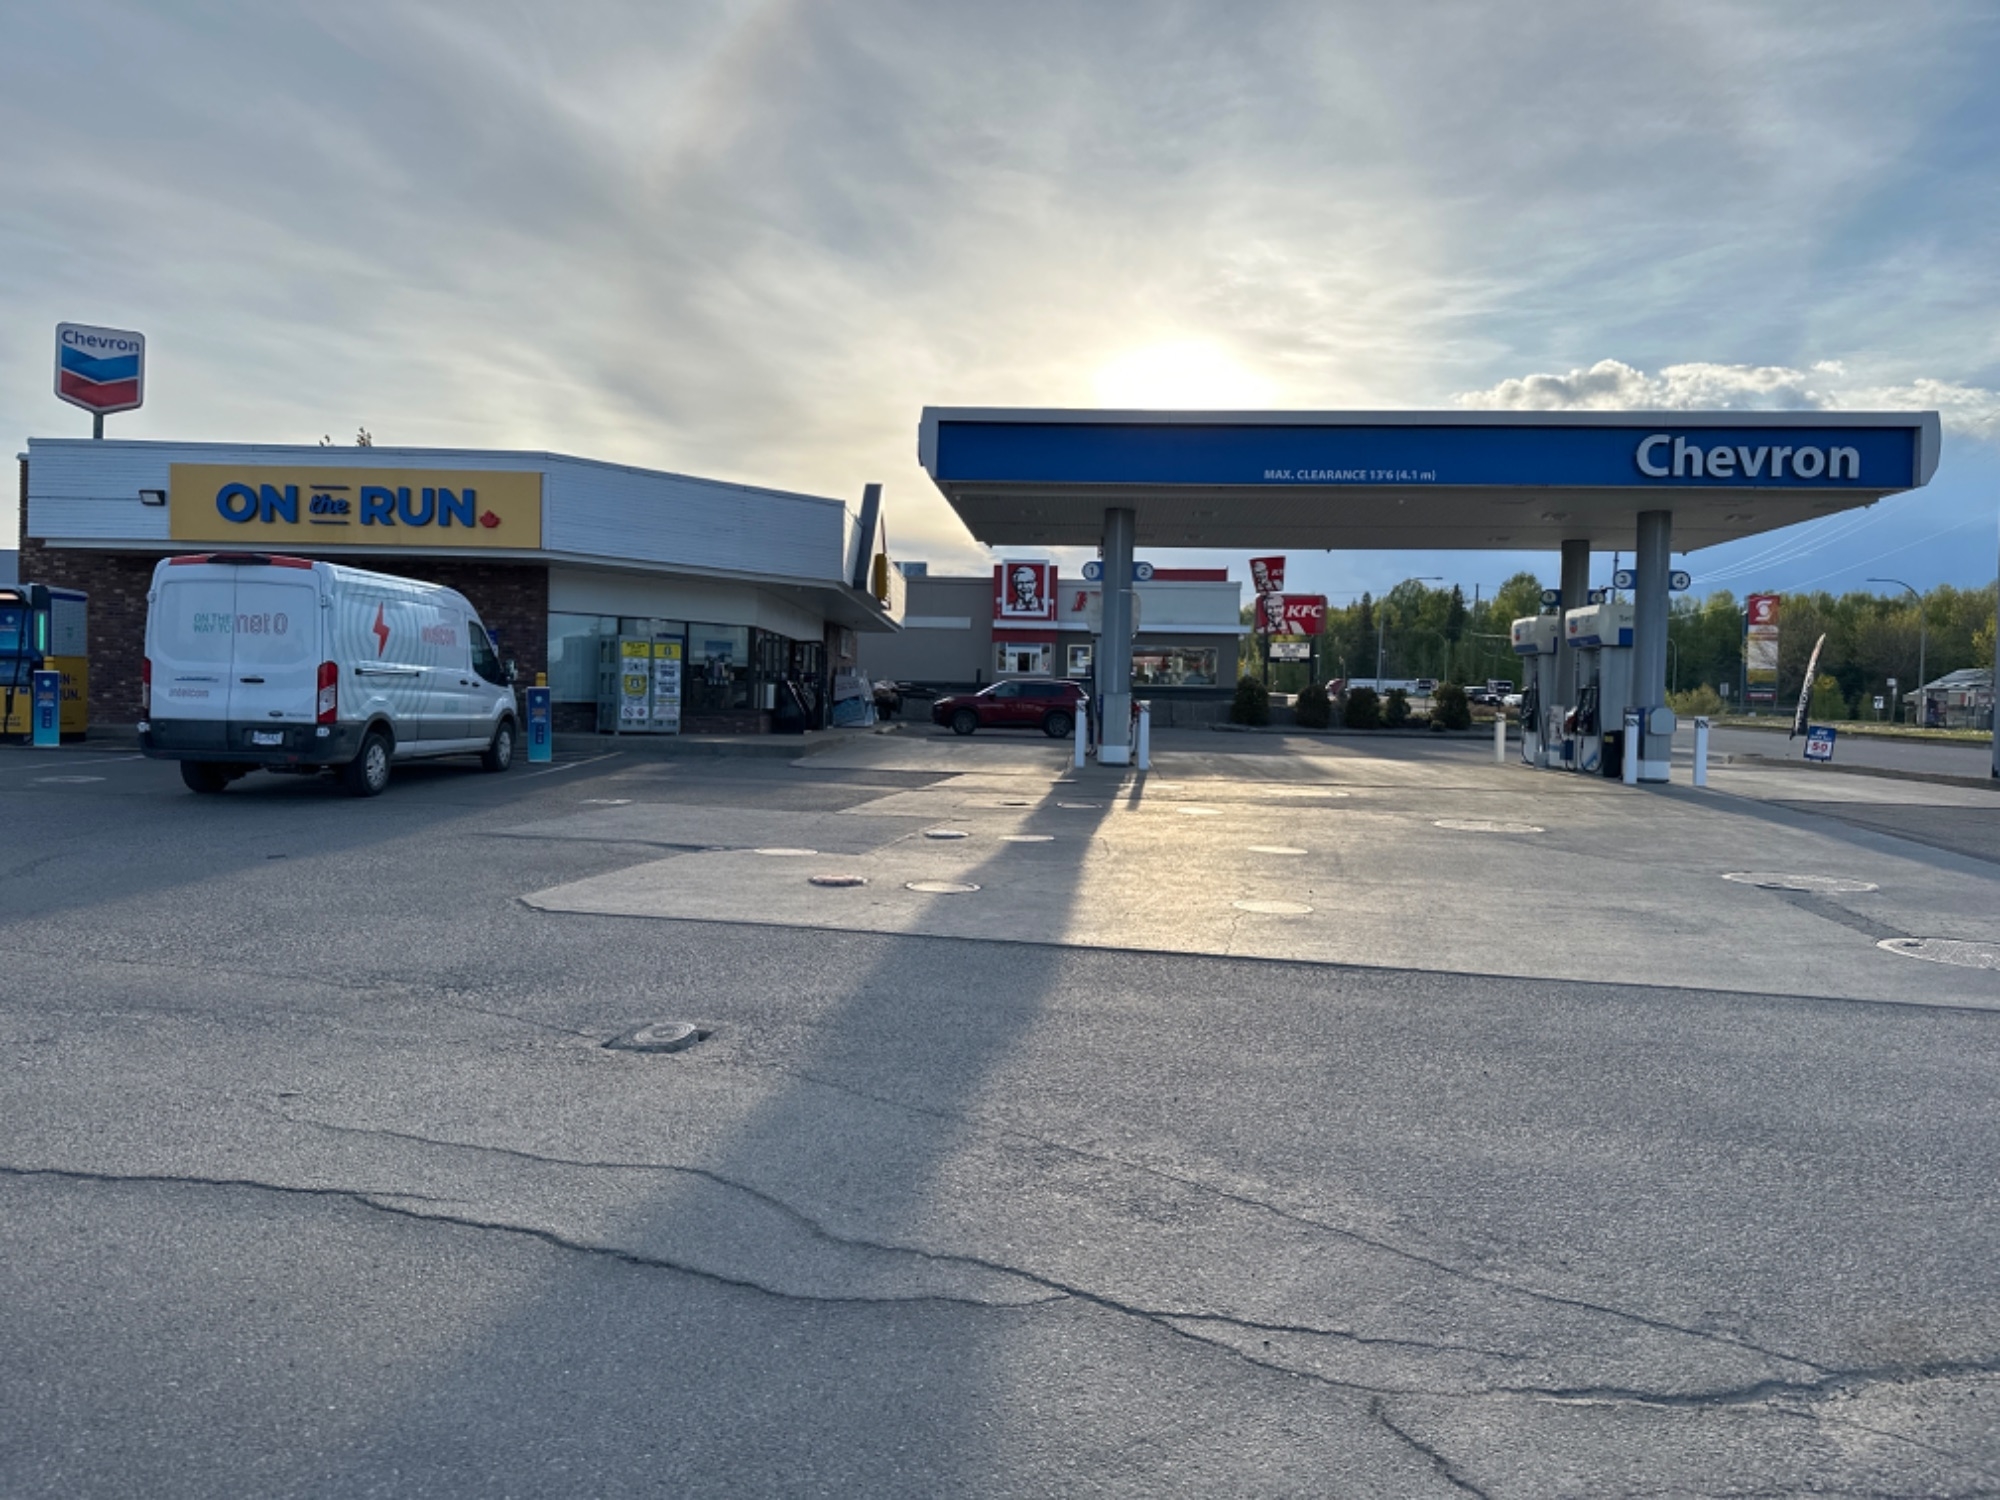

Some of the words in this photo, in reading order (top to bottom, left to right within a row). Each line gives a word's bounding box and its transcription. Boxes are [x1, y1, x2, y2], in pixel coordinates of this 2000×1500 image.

[61, 329, 139, 352] Chevron
[1636, 434, 1860, 479] Chevron
[1264, 469, 1294, 480] MAX.
[1297, 469, 1366, 480] CLEARANCE
[216, 482, 298, 524] ON
[309, 493, 350, 515] the
[360, 486, 476, 527] RUN
[1271, 569, 1283, 577] KF
[1286, 605, 1323, 617] KFC
[194, 613, 209, 623] ON
[212, 613, 232, 623] THE
[194, 623, 216, 633] WAY
